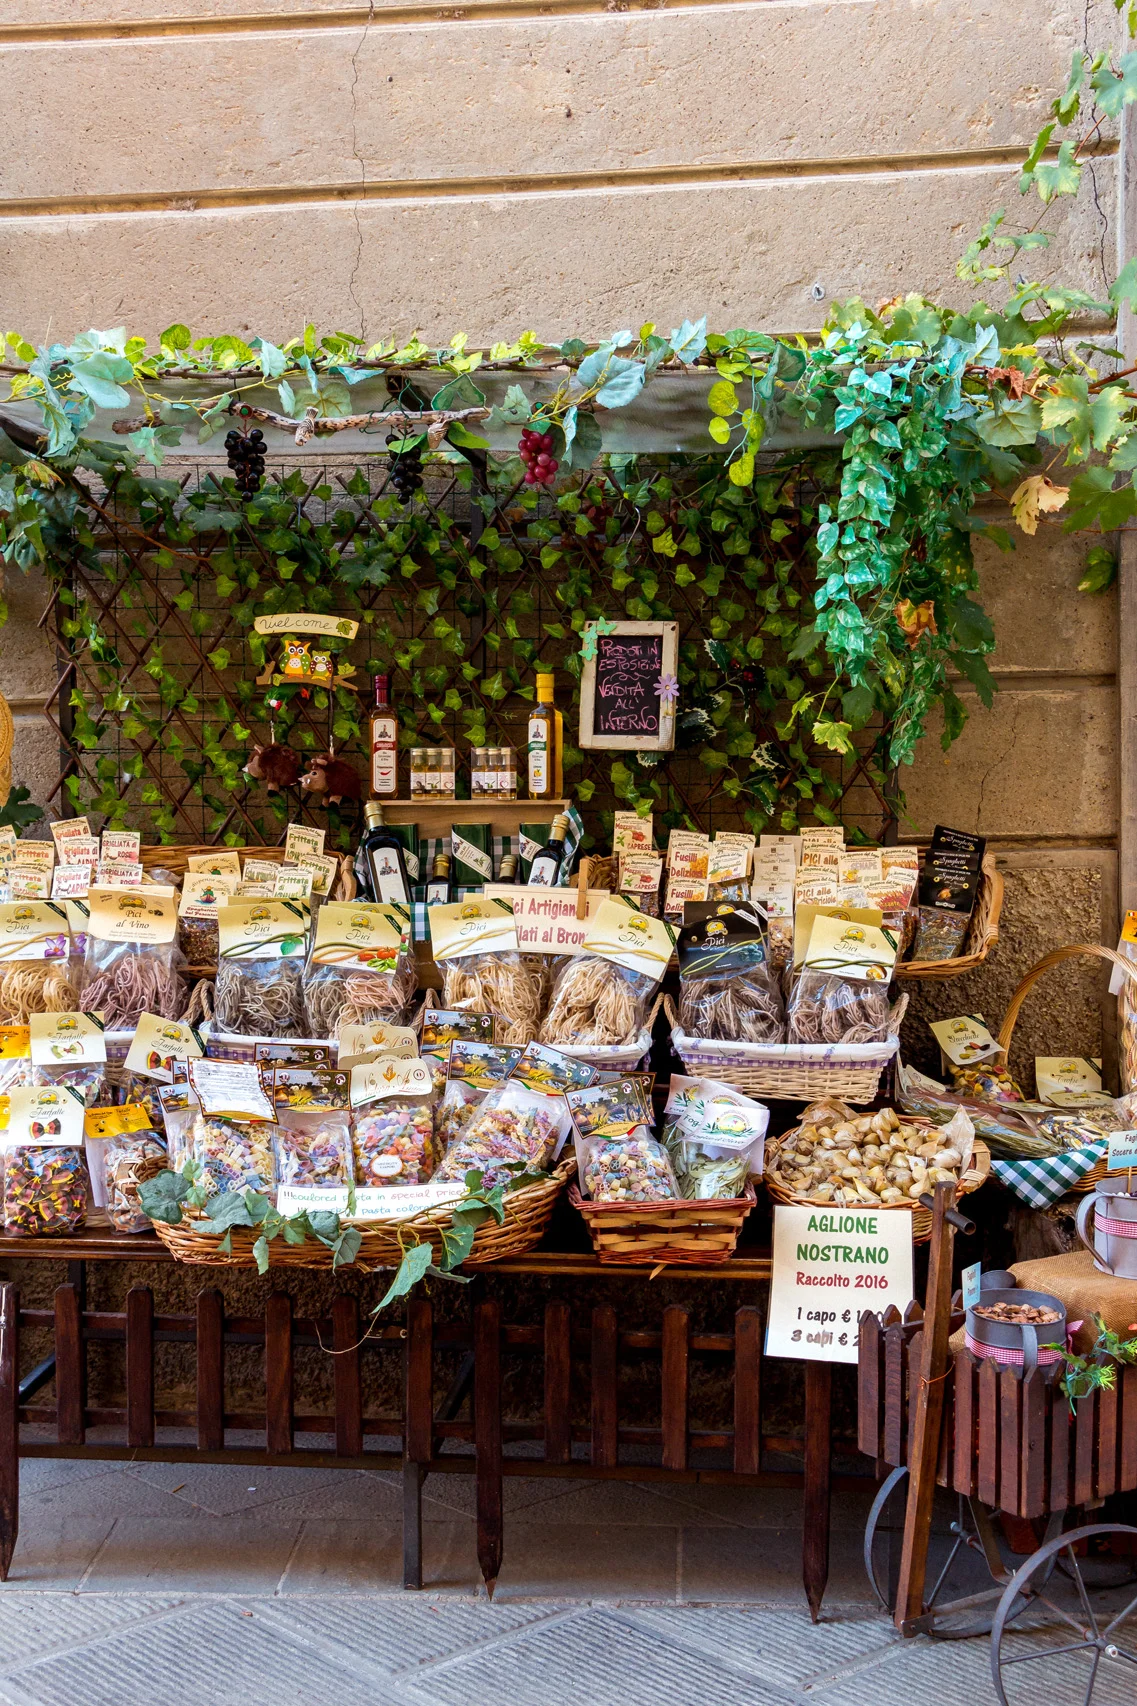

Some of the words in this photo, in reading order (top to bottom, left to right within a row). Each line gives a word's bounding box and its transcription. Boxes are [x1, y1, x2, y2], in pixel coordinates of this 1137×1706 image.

[600, 706, 658, 731] INTERNO
[288, 833, 319, 846] Frittata
[627, 843, 651, 851] CAPRESE
[674, 851, 698, 862] Fusilli
[803, 852, 821, 864] PICI
[823, 854, 839, 866] alle
[939, 856, 966, 867] Spaghetti
[300, 859, 331, 874] Frittata
[278, 876, 309, 885] Frittata
[939, 872, 966, 882] Spaghetti
[671, 888, 694, 898] Fusilli
[796, 888, 814, 899] PICI
[816, 887, 832, 896] alle
[125, 909, 142, 918] Pici
[512, 897, 524, 914] ci
[528, 897, 590, 920] Artigiani
[6, 920, 30, 933] Pici
[116, 919, 127, 928] al
[129, 920, 150, 929] Vino
[244, 922, 271, 936] Pici
[459, 922, 487, 936] Pici
[345, 928, 371, 942] Pici
[542, 927, 553, 943] al
[557, 927, 588, 945] Bron
[618, 931, 647, 948] Pici
[701, 936, 726, 951] Pici
[833, 940, 858, 952] Pici
[49, 1032, 85, 1043] Farfalle
[151, 1039, 184, 1054] Farfalle
[29, 1107, 65, 1119] Farfalle
[343, 1193, 372, 1203] psta
[391, 1189, 430, 1201] special
[362, 1206, 391, 1215] pasta
[807, 1215, 878, 1235] AGLIONE
[796, 1243, 889, 1265] NOSTRANO
[796, 1271, 850, 1288] Raccolto
[854, 1274, 889, 1290] 2016
[806, 1309, 837, 1326] capo
[841, 1309, 851, 1324] €
[790, 1329, 803, 1343] 3
[806, 1330, 834, 1348] capi
[838, 1332, 848, 1346] €
